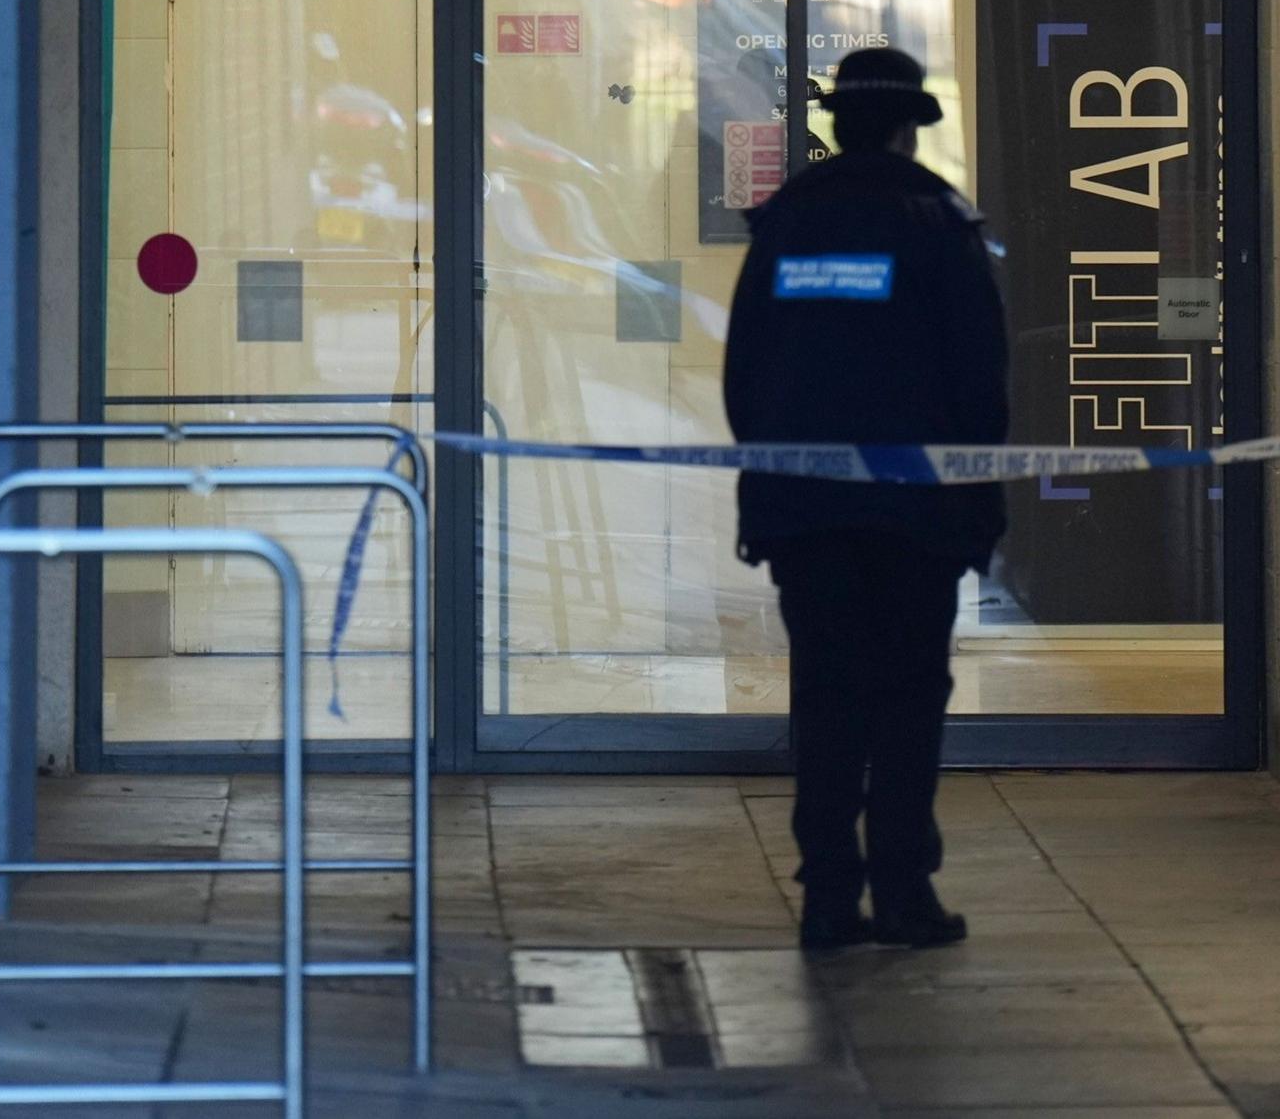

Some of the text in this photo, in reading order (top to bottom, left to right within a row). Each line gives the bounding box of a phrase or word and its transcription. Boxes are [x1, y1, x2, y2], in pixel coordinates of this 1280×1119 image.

[830, 33, 889, 49] TIMES
[779, 261, 888, 276] POLICE COMMUNITY
[784, 276, 883, 290] SUPPORT OFFICER
[1167, 298, 1212, 308] Automatic
[1178, 310, 1200, 318] Door
[943, 452, 1138, 478] POLICE LINE DO NOT CROSS
